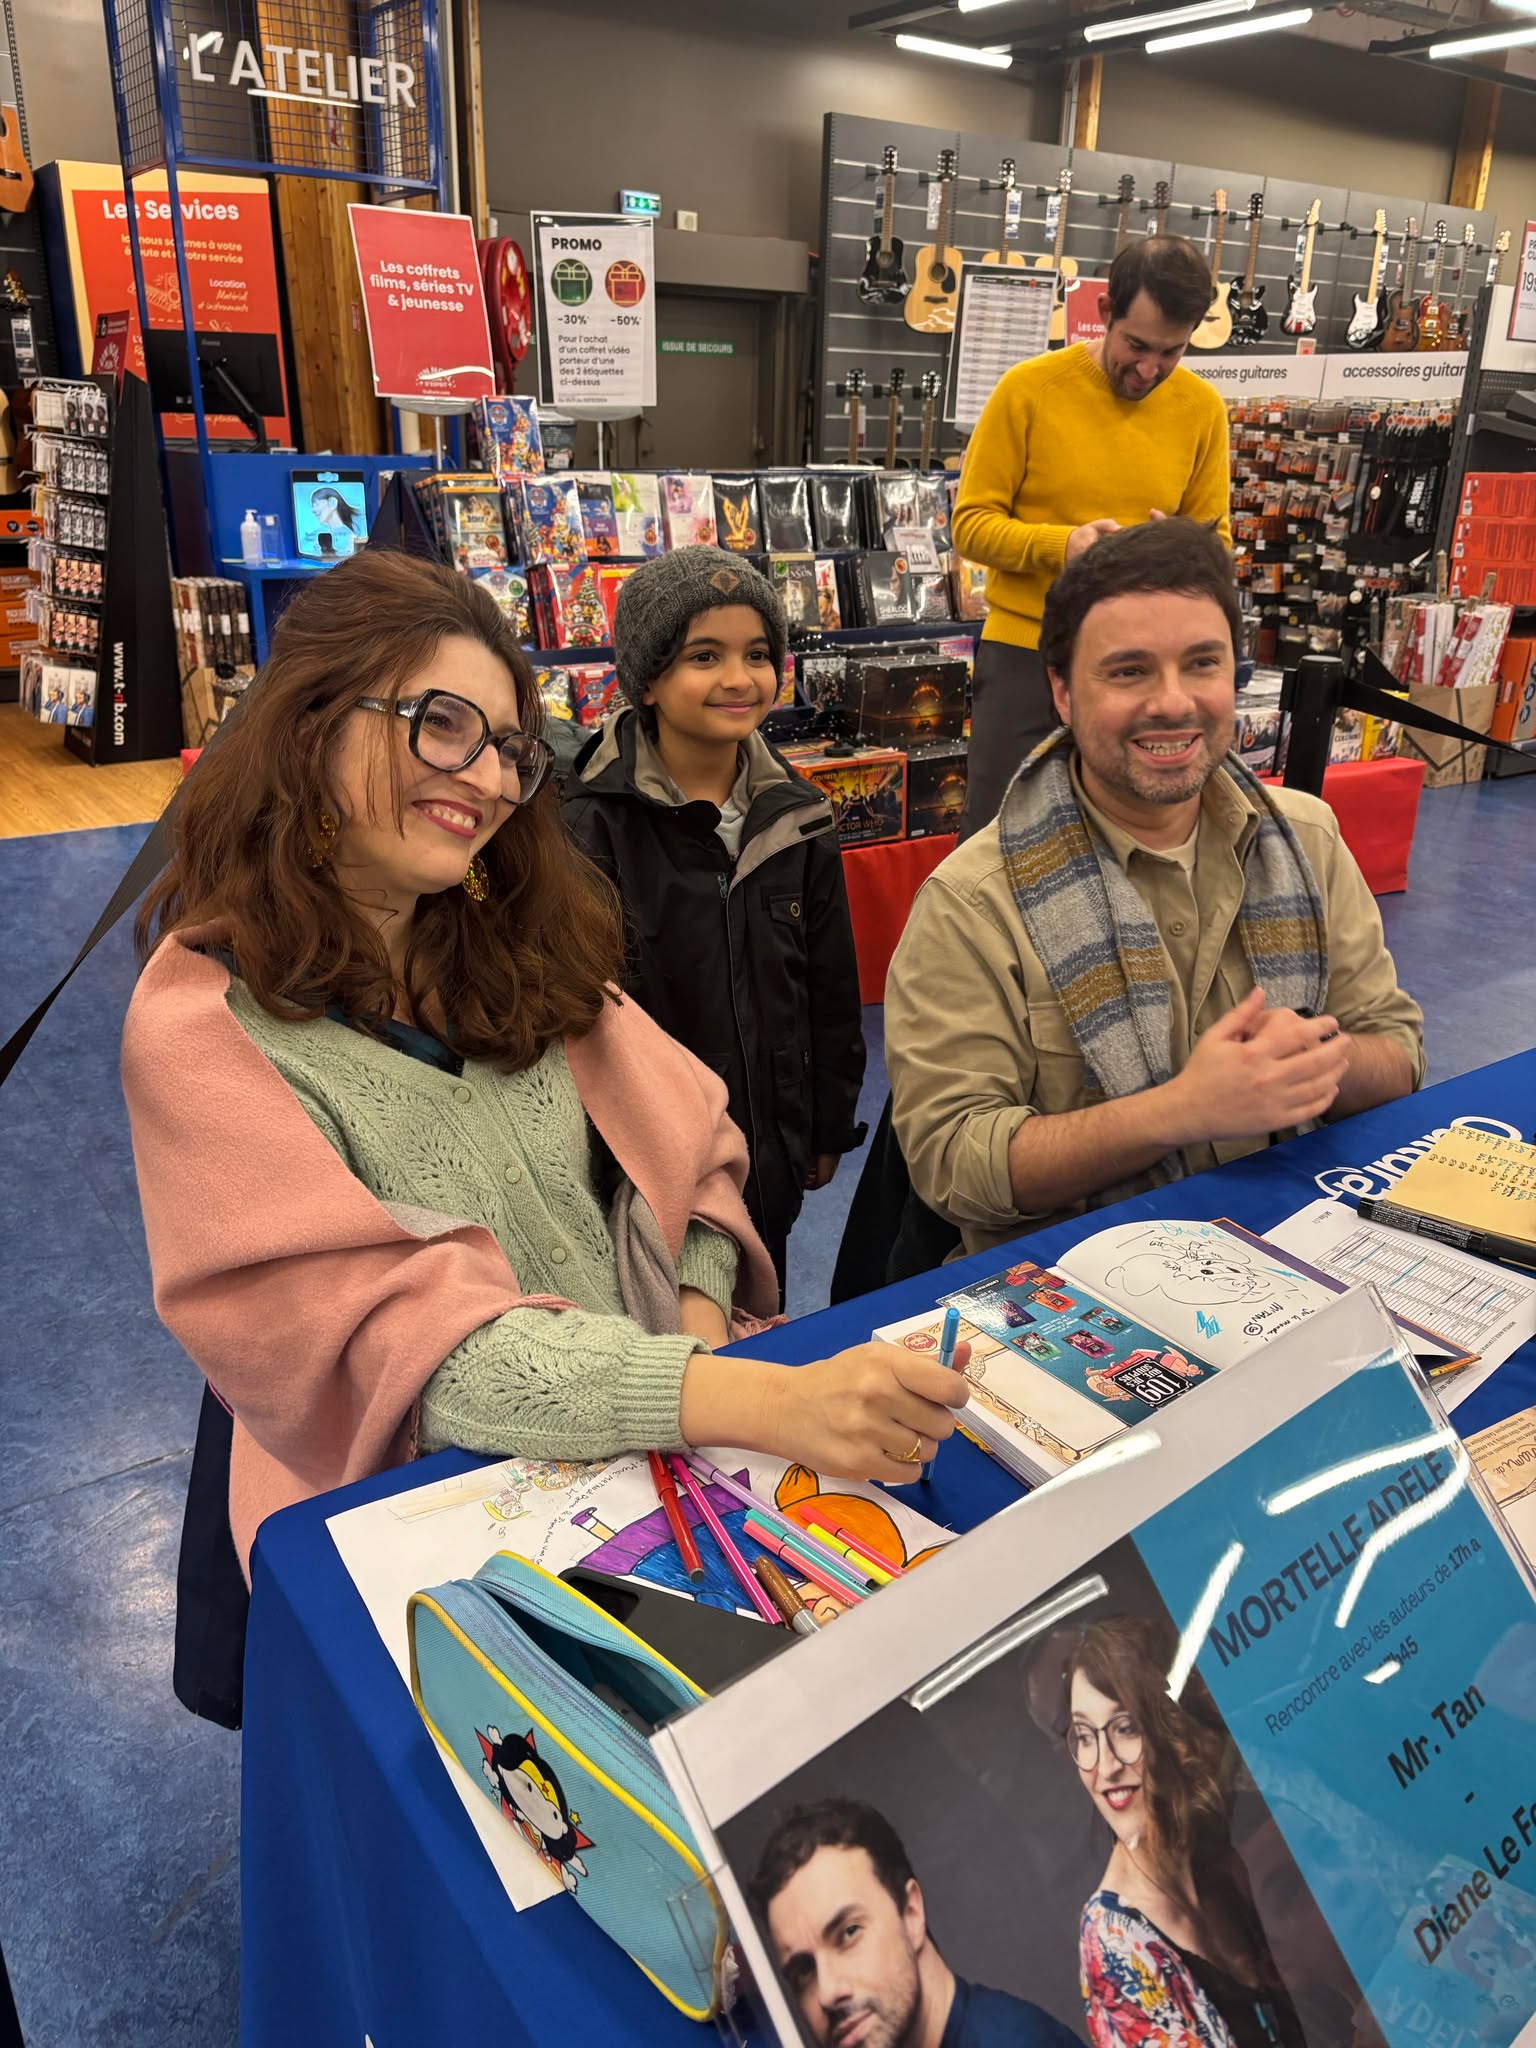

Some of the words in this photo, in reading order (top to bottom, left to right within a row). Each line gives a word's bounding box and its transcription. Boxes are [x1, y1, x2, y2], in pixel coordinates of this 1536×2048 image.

[102, 199, 140, 219] Les
[144, 198, 240, 220] Sevices
[164, 238, 207, 249] somes
[217, 241, 242, 251] votre
[551, 237, 602, 251] PROMO
[124, 246, 159, 258] éoute
[208, 254, 244, 264] service
[380, 260, 404, 274] Les
[406, 263, 461, 280] coffrets
[209, 278, 246, 289] Location
[370, 274, 411, 292] films,
[412, 278, 455, 294] séries
[456, 282, 474, 297] TV
[387, 293, 399, 307] &
[401, 293, 464, 312] jeunesse
[558, 335, 577, 344] Pour
[579, 334, 608, 344] l'achat
[662, 341, 684, 352] ISSUE
[686, 342, 697, 352] DE
[698, 342, 734, 354] SECOURS
[558, 346, 578, 354] d'un
[579, 345, 606, 354] coffret
[607, 345, 631, 355] vidéo
[559, 358, 590, 366] porteur
[591, 356, 615, 365] d'une
[560, 367, 574, 376] des
[576, 367, 582, 375] 2
[583, 367, 624, 377] étiquettes
[1239, 365, 1288, 383] guitares
[1343, 362, 1421, 379] accessoires
[1422, 361, 1467, 382] guitar
[560, 378, 601, 387] ci-dessus
[113, 642, 125, 746] www.t-nb.com
[1118, 1363, 1153, 1384] SOUPIRS
[1126, 1376, 1145, 1388] DES
[1142, 1367, 1162, 1380] RUE
[1135, 1373, 1181, 1402] 109
[1207, 1513, 1365, 1667] MORTELLE
[1265, 1665, 1341, 1737] Rencontre
[1341, 1633, 1372, 1672] avec
[1367, 1618, 1391, 1643] les
[1390, 1578, 1436, 1627] auteurs
[1433, 1558, 1452, 1585] de
[1448, 1543, 1473, 1572] 17h
[1386, 1735, 1441, 1790] Mr.
[1430, 1684, 1486, 1740] Tan
[1412, 1869, 1492, 1965] Diane
[1481, 1835, 1521, 1880] Le
